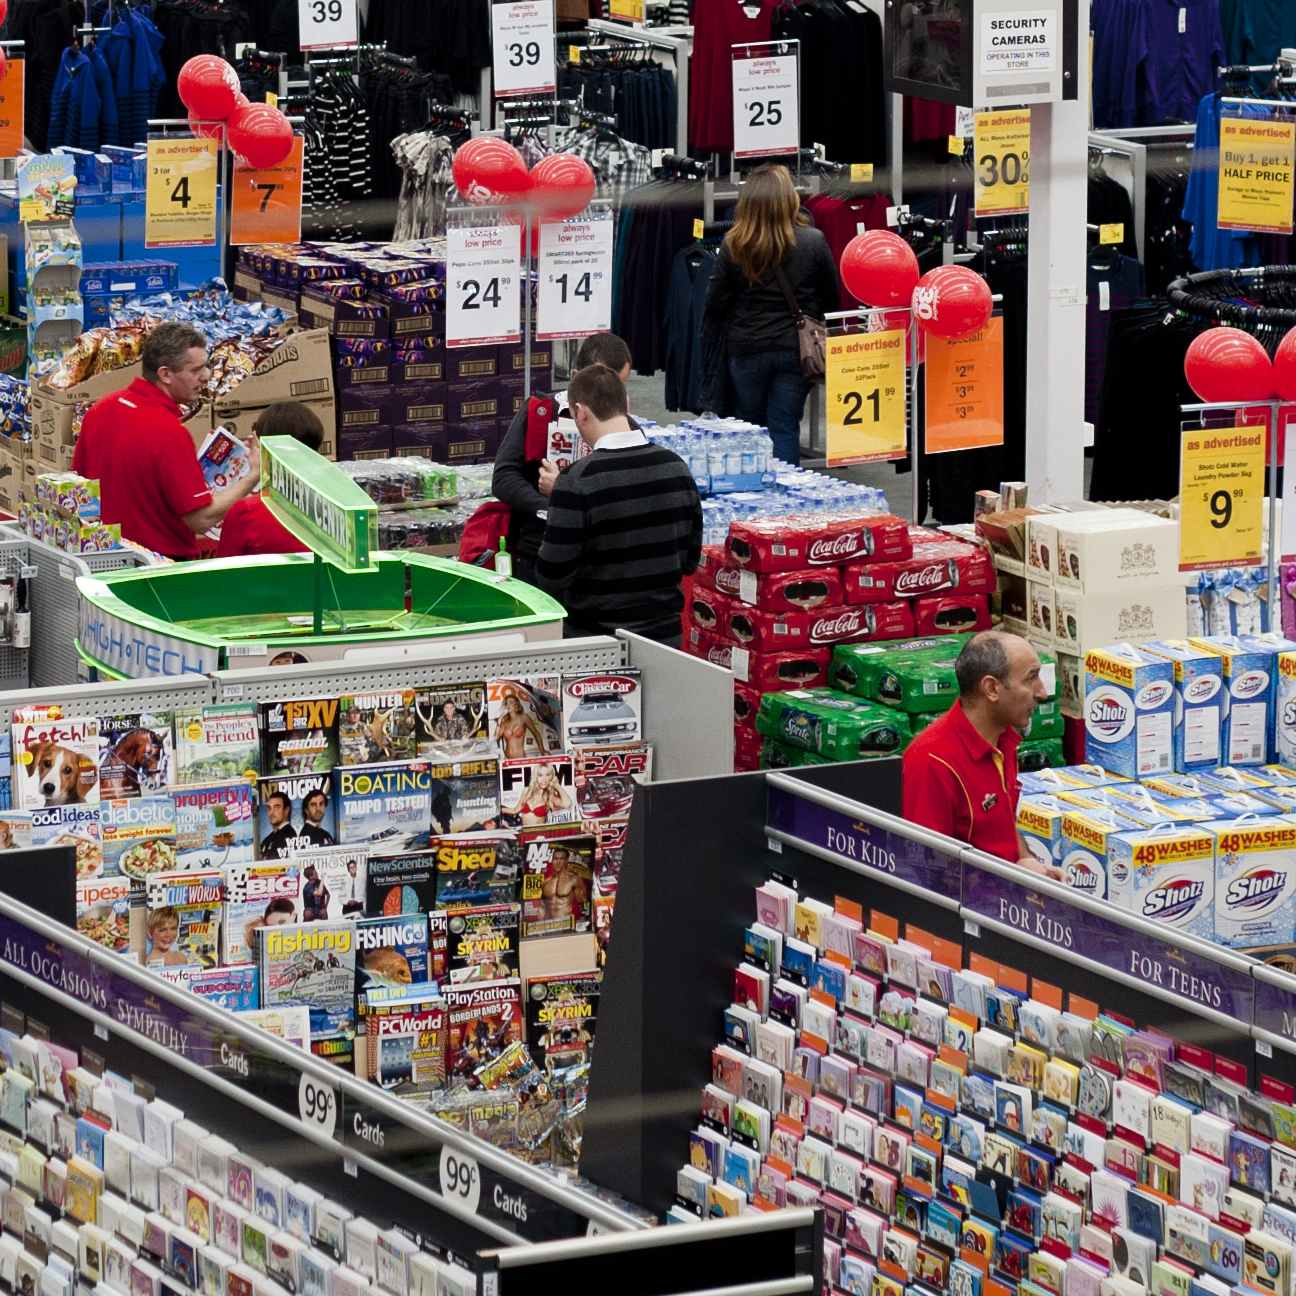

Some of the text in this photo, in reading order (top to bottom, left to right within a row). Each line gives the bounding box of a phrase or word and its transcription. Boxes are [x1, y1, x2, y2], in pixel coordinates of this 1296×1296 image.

[991, 19, 1047, 30] SECURITY
[992, 35, 1046, 46] CAMERAS
[987, 51, 1024, 60] OPERATING
[168, 145, 208, 154] advertised
[1225, 152, 1242, 165] Buy
[1262, 154, 1279, 167] get
[1284, 155, 1290, 166] 1
[1225, 168, 1289, 183] HALF PRICE
[465, 239, 502, 248] low price
[272, 454, 310, 516] BATTERY
[85, 619, 204, 677] HIGH TECH
[23, 724, 86, 752] fetch!
[205, 728, 256, 744] Friend
[341, 772, 430, 795] BOATING
[345, 793, 429, 815] TAUPO TESTED!
[438, 848, 496, 871] Shed
[827, 828, 896, 873] FOR KIDS
[1135, 836, 1213, 868] 48 WASHES
[267, 929, 351, 955] fishing
[457, 937, 509, 954] SKYRIM
[4, 935, 107, 1008] ALL OCCASIONS
[1130, 951, 1222, 1007] FOR TEENS
[448, 986, 515, 1005] PlayStation
[117, 998, 188, 1054] SYMPATHY
[221, 1042, 249, 1077] Cards
